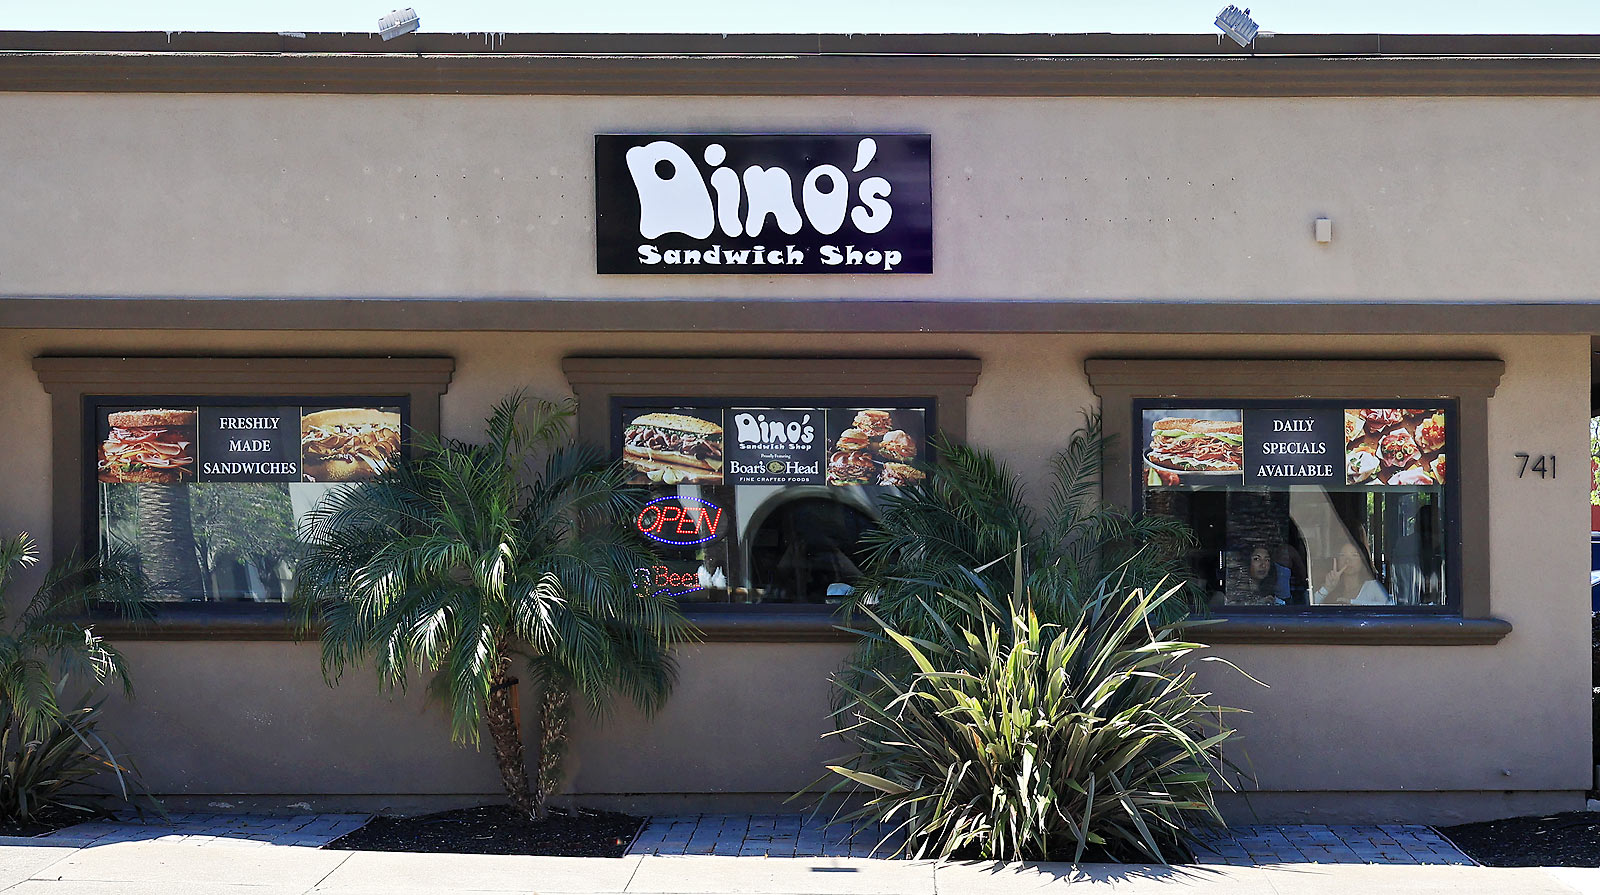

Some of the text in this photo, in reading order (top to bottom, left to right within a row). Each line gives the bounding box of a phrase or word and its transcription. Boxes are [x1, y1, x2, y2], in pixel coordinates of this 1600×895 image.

[625, 137, 893, 240] Dino's
[637, 244, 902, 271] Sandwich Shop
[219, 417, 280, 430] FRESHLY
[734, 413, 815, 444] Dino's
[1273, 419, 1315, 432] DAILY
[229, 440, 271, 453] MADE
[788, 443, 812, 451] Shop
[1262, 442, 1327, 455] SPECIALS
[203, 462, 297, 475] SANDWICHES
[730, 460, 819, 474] Boar's Head
[1257, 464, 1334, 477] AVAILABLE
[1514, 452, 1557, 479] 741
[637, 505, 722, 535] OPEN
